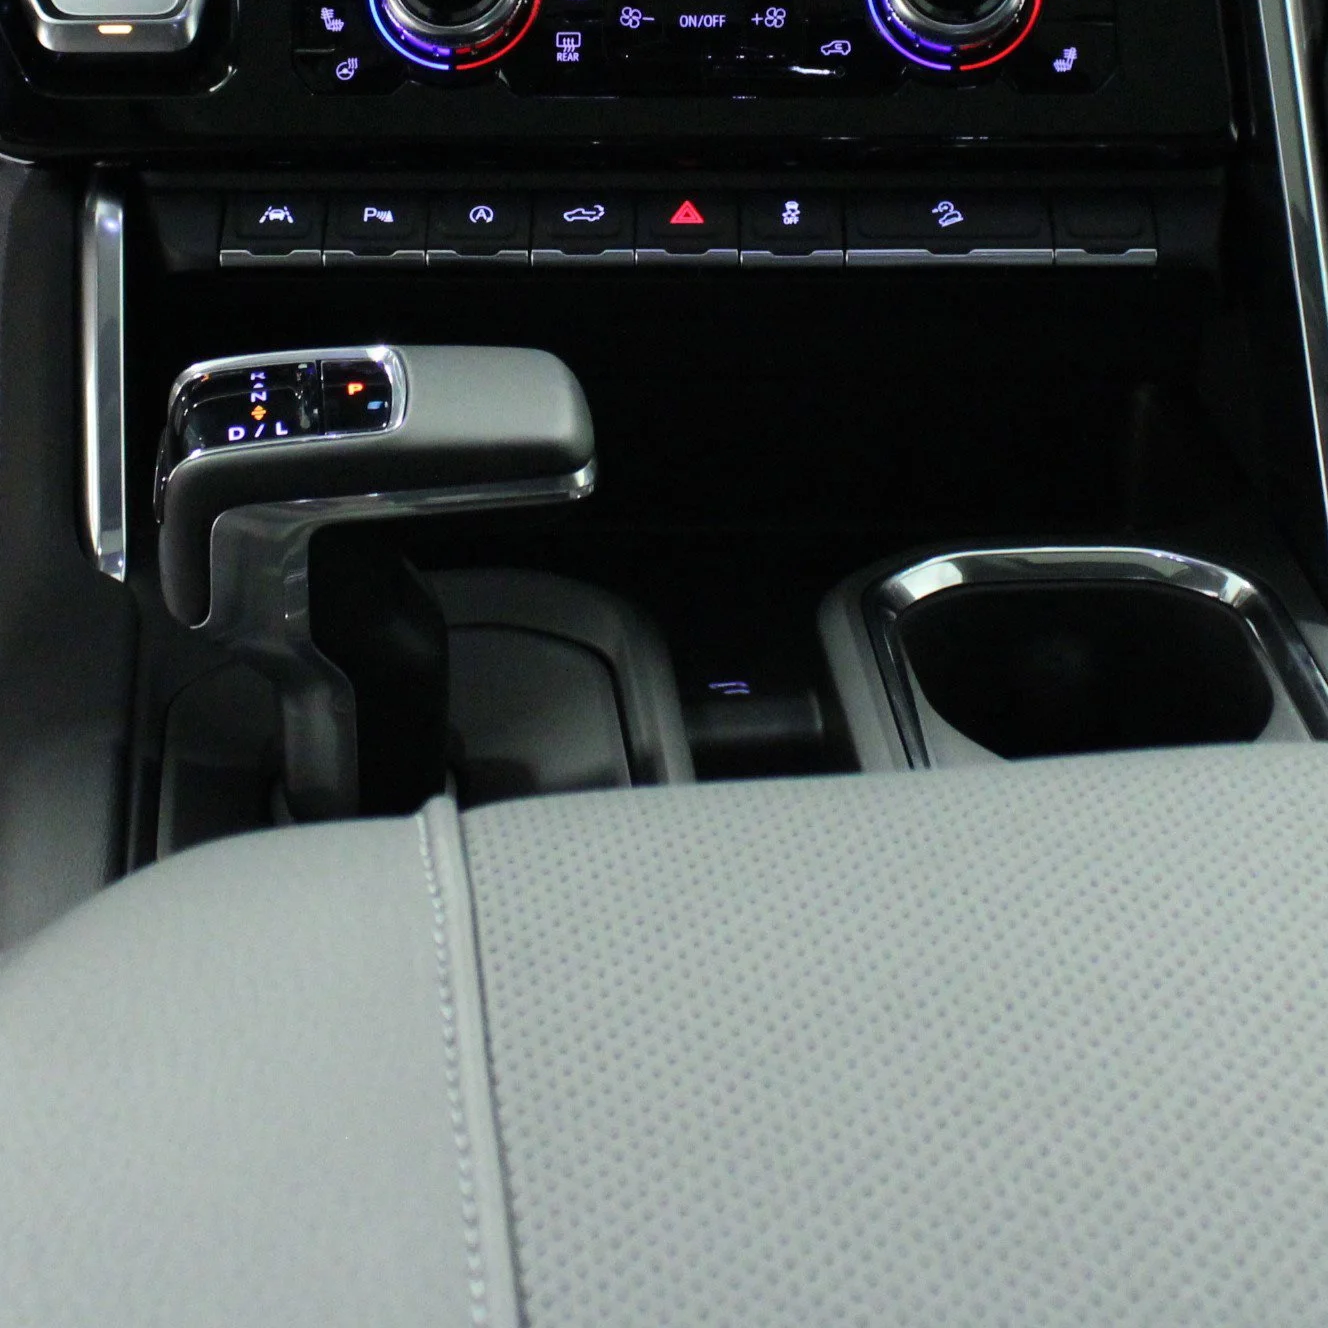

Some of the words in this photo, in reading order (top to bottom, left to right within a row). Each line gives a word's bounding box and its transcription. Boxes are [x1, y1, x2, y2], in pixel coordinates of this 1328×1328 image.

[679, 14, 726, 28] ON/OFF
[557, 51, 579, 61] REAR
[783, 217, 799, 225] OFF
[347, 383, 364, 395] P
